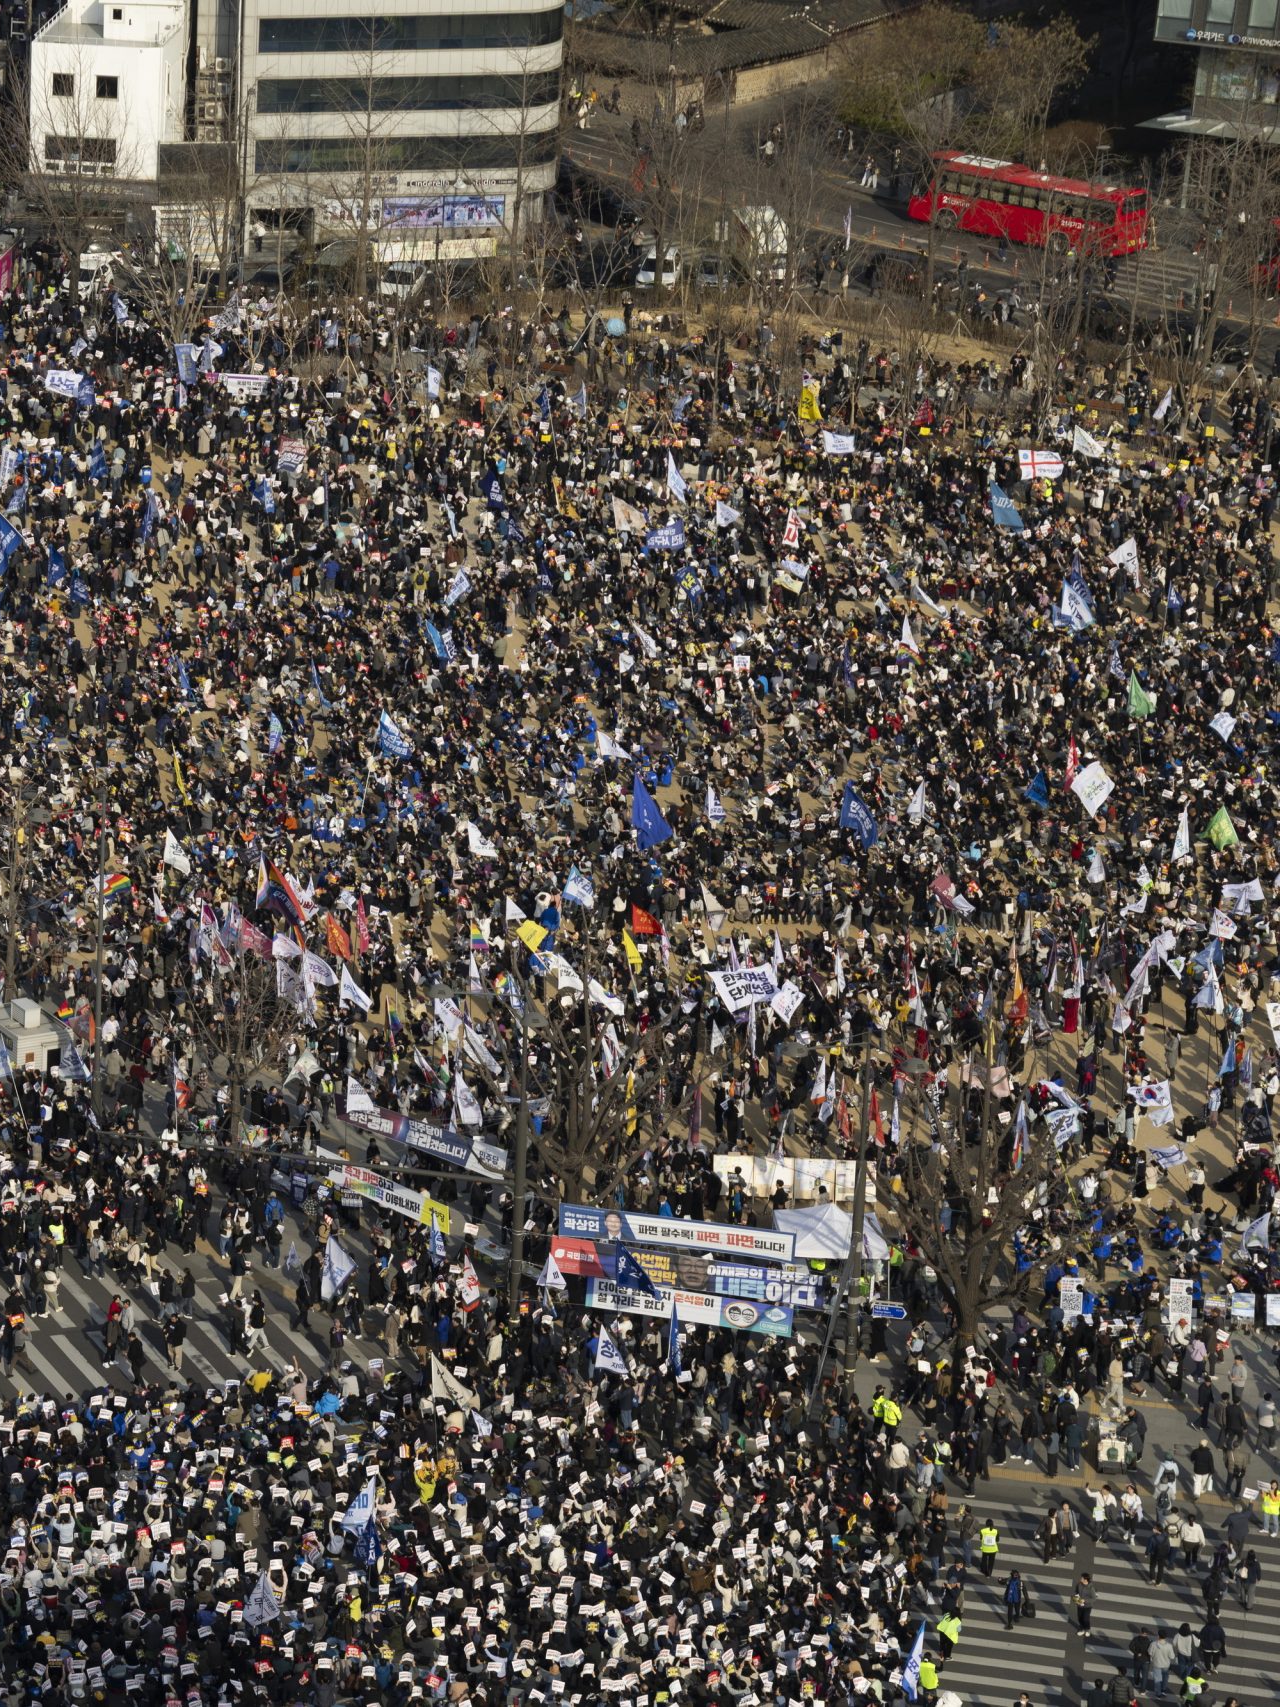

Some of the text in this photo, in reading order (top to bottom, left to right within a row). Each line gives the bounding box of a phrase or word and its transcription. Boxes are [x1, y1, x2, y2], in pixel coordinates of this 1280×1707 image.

[1197, 30, 1225, 42] 우리카드
[367, 1114, 394, 1135] 경제
[408, 1119, 444, 1139] 민주당이
[406, 1130, 468, 1161] 살리겠습니다!
[345, 1165, 362, 1181] 즉각
[362, 1171, 396, 1192] 파면하고
[563, 1217, 600, 1233] 곽상언
[638, 1224, 658, 1236] 파면
[661, 1225, 694, 1240] 팔수록!
[725, 1233, 785, 1253] 파면입니다!
[715, 1276, 817, 1307] 내란이다
[597, 1293, 665, 1312] 설 자리는 없다
